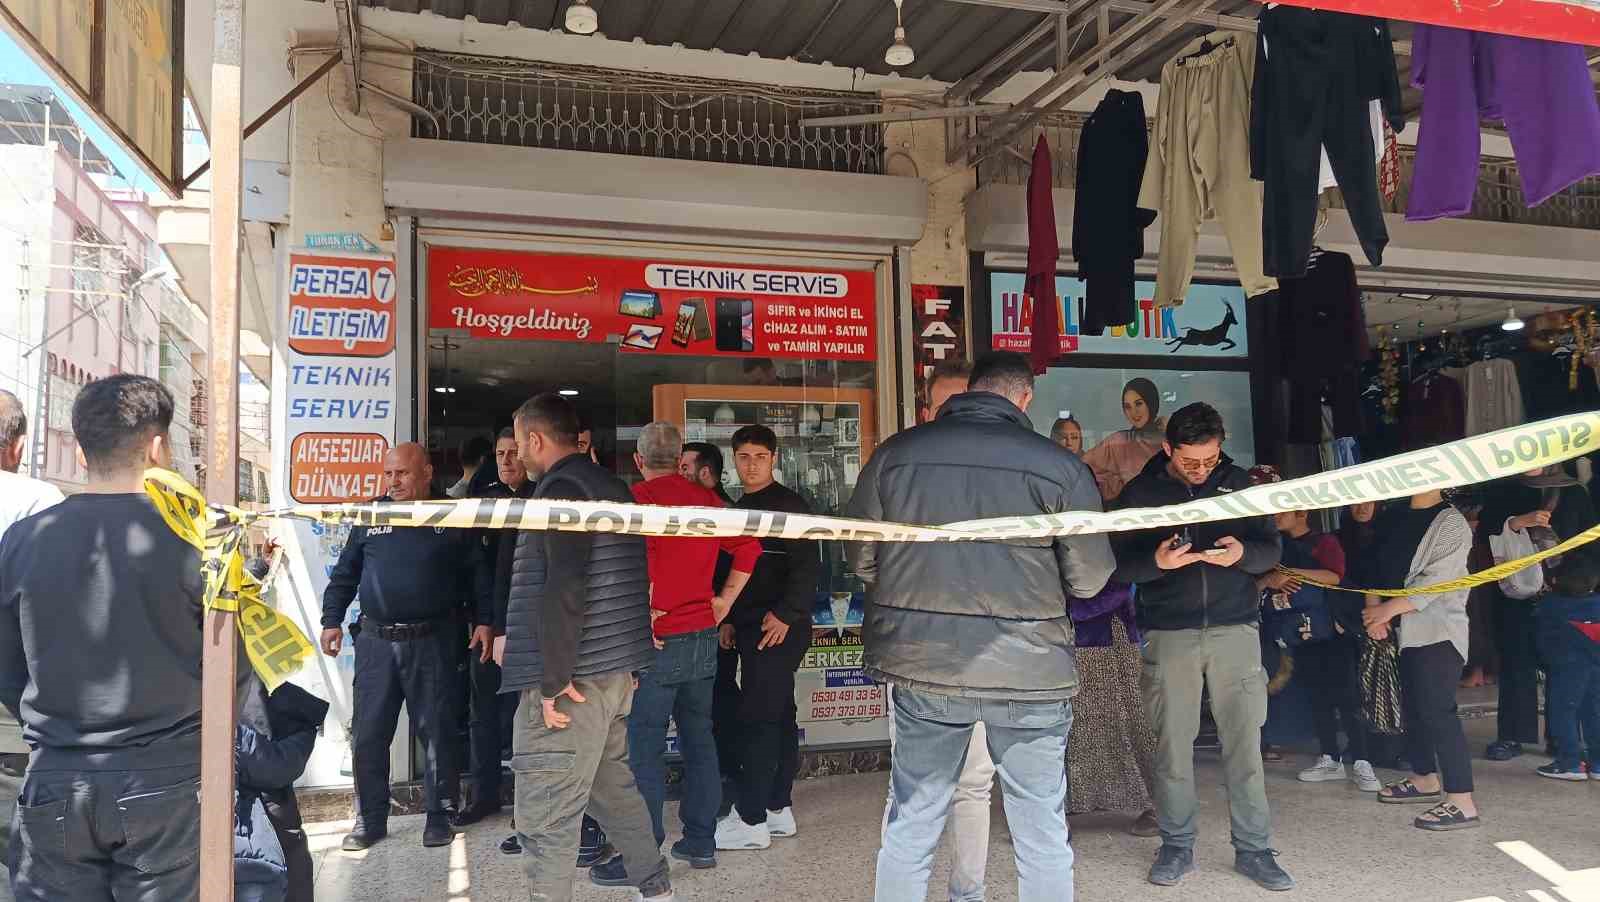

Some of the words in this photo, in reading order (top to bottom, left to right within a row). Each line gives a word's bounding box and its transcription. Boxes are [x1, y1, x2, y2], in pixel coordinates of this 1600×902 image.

[293, 267, 369, 296] PERSA
[377, 271, 392, 300] 7
[656, 267, 746, 291] TEKNİK
[752, 272, 838, 295] SERVİS
[451, 306, 592, 338] Hoşgeldiniz
[767, 304, 796, 317] SIFIR
[799, 307, 811, 318] ve
[814, 304, 848, 320] İKİNCİ
[850, 308, 864, 320] EL
[292, 309, 387, 347] İLETİŞİM
[763, 321, 798, 334] CİHAZ
[800, 324, 827, 336] ALIM
[835, 325, 868, 337] SATIM
[767, 342, 781, 352] ve
[782, 339, 820, 353] TAMİRİ
[823, 341, 865, 355] YAPILIR
[291, 364, 392, 387] TEKNİK
[290, 399, 390, 420] SERVİS
[296, 438, 384, 464] AKSESUAR
[296, 467, 382, 498] DÜNYASI
